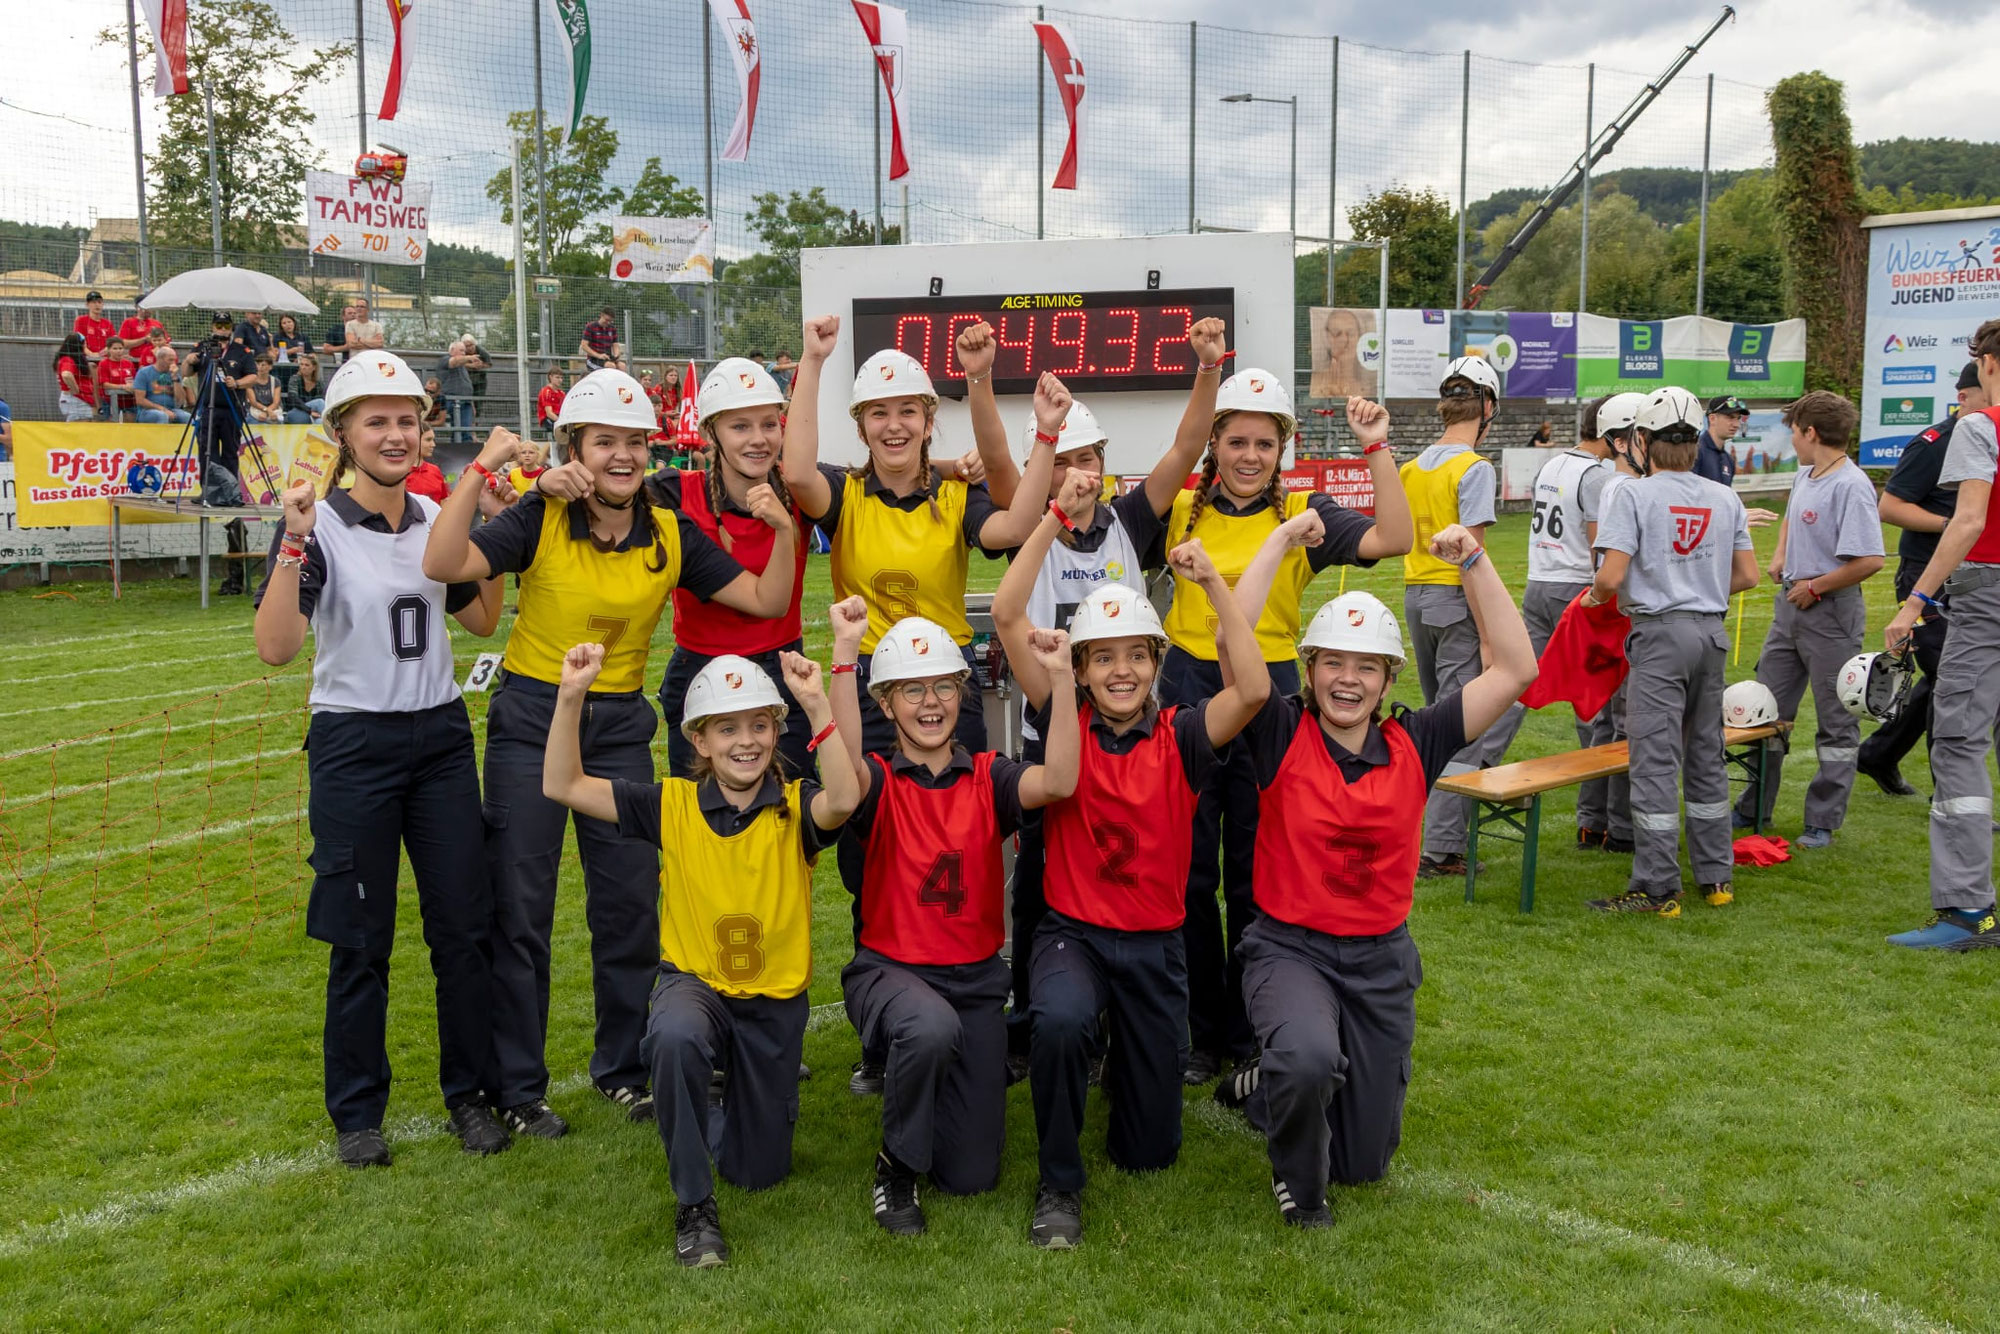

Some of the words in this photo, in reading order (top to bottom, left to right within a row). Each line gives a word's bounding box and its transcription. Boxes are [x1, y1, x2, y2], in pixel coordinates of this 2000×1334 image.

[314, 195, 426, 230] TAMSWEG
[312, 234, 342, 254] TOI
[362, 233, 389, 251] TOI
[404, 236, 423, 262] TOI
[1887, 239, 1954, 274] Weiz
[1001, 295, 1083, 309] ALGE-TIMING
[1891, 288, 1954, 305] JUGEND
[1957, 284, 2000, 292] LEISTUN
[1907, 335, 1938, 347] Weiz
[51, 452, 125, 481] Pfeif
[32, 489, 67, 501] lass
[71, 486, 97, 499] die
[1331, 494, 1374, 508] BERWART
[1532, 500, 1563, 539] 56
[388, 593, 430, 662] 0
[586, 614, 630, 665] 7
[472, 659, 494, 686] 3
[1096, 820, 1139, 889] 2
[1321, 831, 1378, 898] 3
[916, 850, 968, 918] 4
[713, 913, 767, 983] 8
